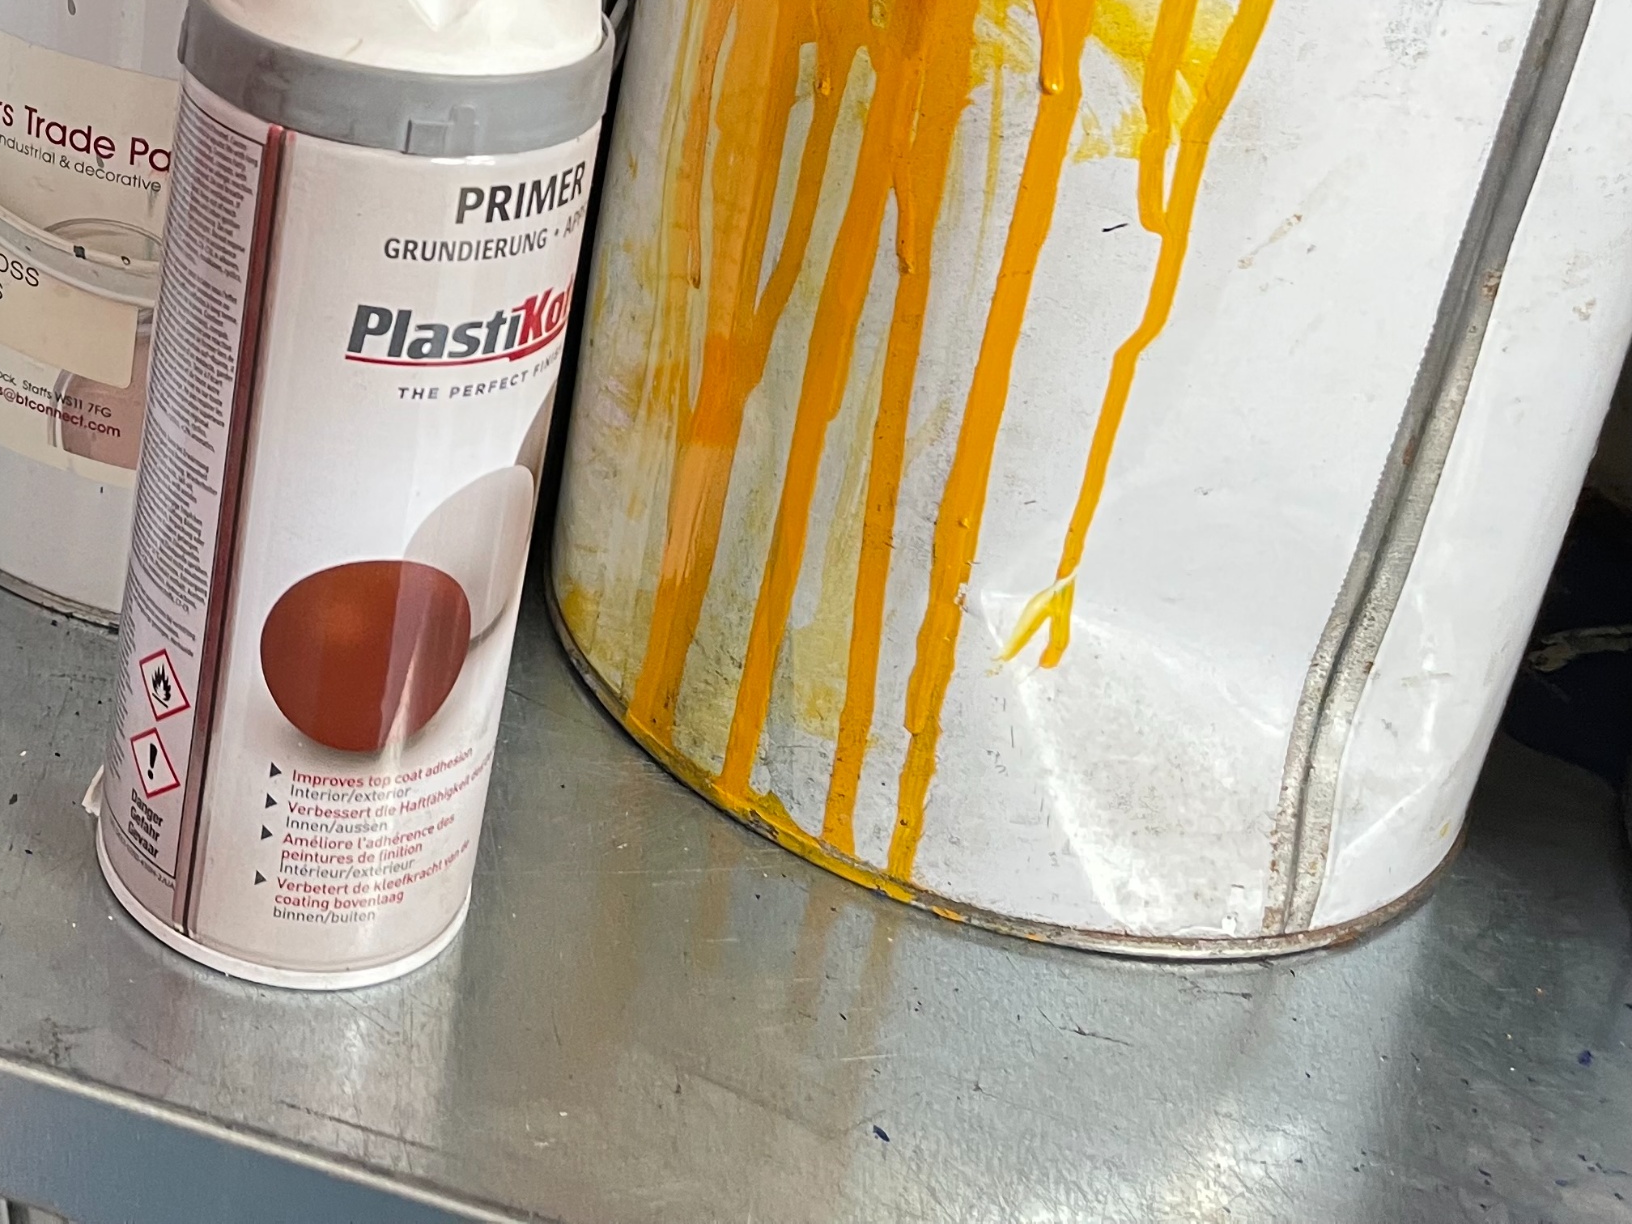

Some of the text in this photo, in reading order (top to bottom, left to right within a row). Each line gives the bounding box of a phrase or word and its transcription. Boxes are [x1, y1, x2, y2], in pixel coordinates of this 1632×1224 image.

[25, 104, 116, 160] Trade
[74, 160, 162, 192] decorative
[455, 161, 586, 224] PRIMER
[384, 228, 548, 262] GRUNDIERUNG
[398, 370, 528, 400] THE PERFECT
[55, 392, 112, 418] WS11 7FG
[292, 747, 473, 788] Improves coat adhesion
[290, 785, 412, 803] Interior/exterior
[288, 800, 372, 819] Verbessert
[286, 816, 388, 834] Innen/aussen
[282, 833, 353, 850] Améliore
[281, 842, 423, 865] peintures finition
[277, 877, 349, 895] Verbetert
[275, 890, 404, 912] coating bovenlaag
[272, 907, 376, 924] binnen/buiten
